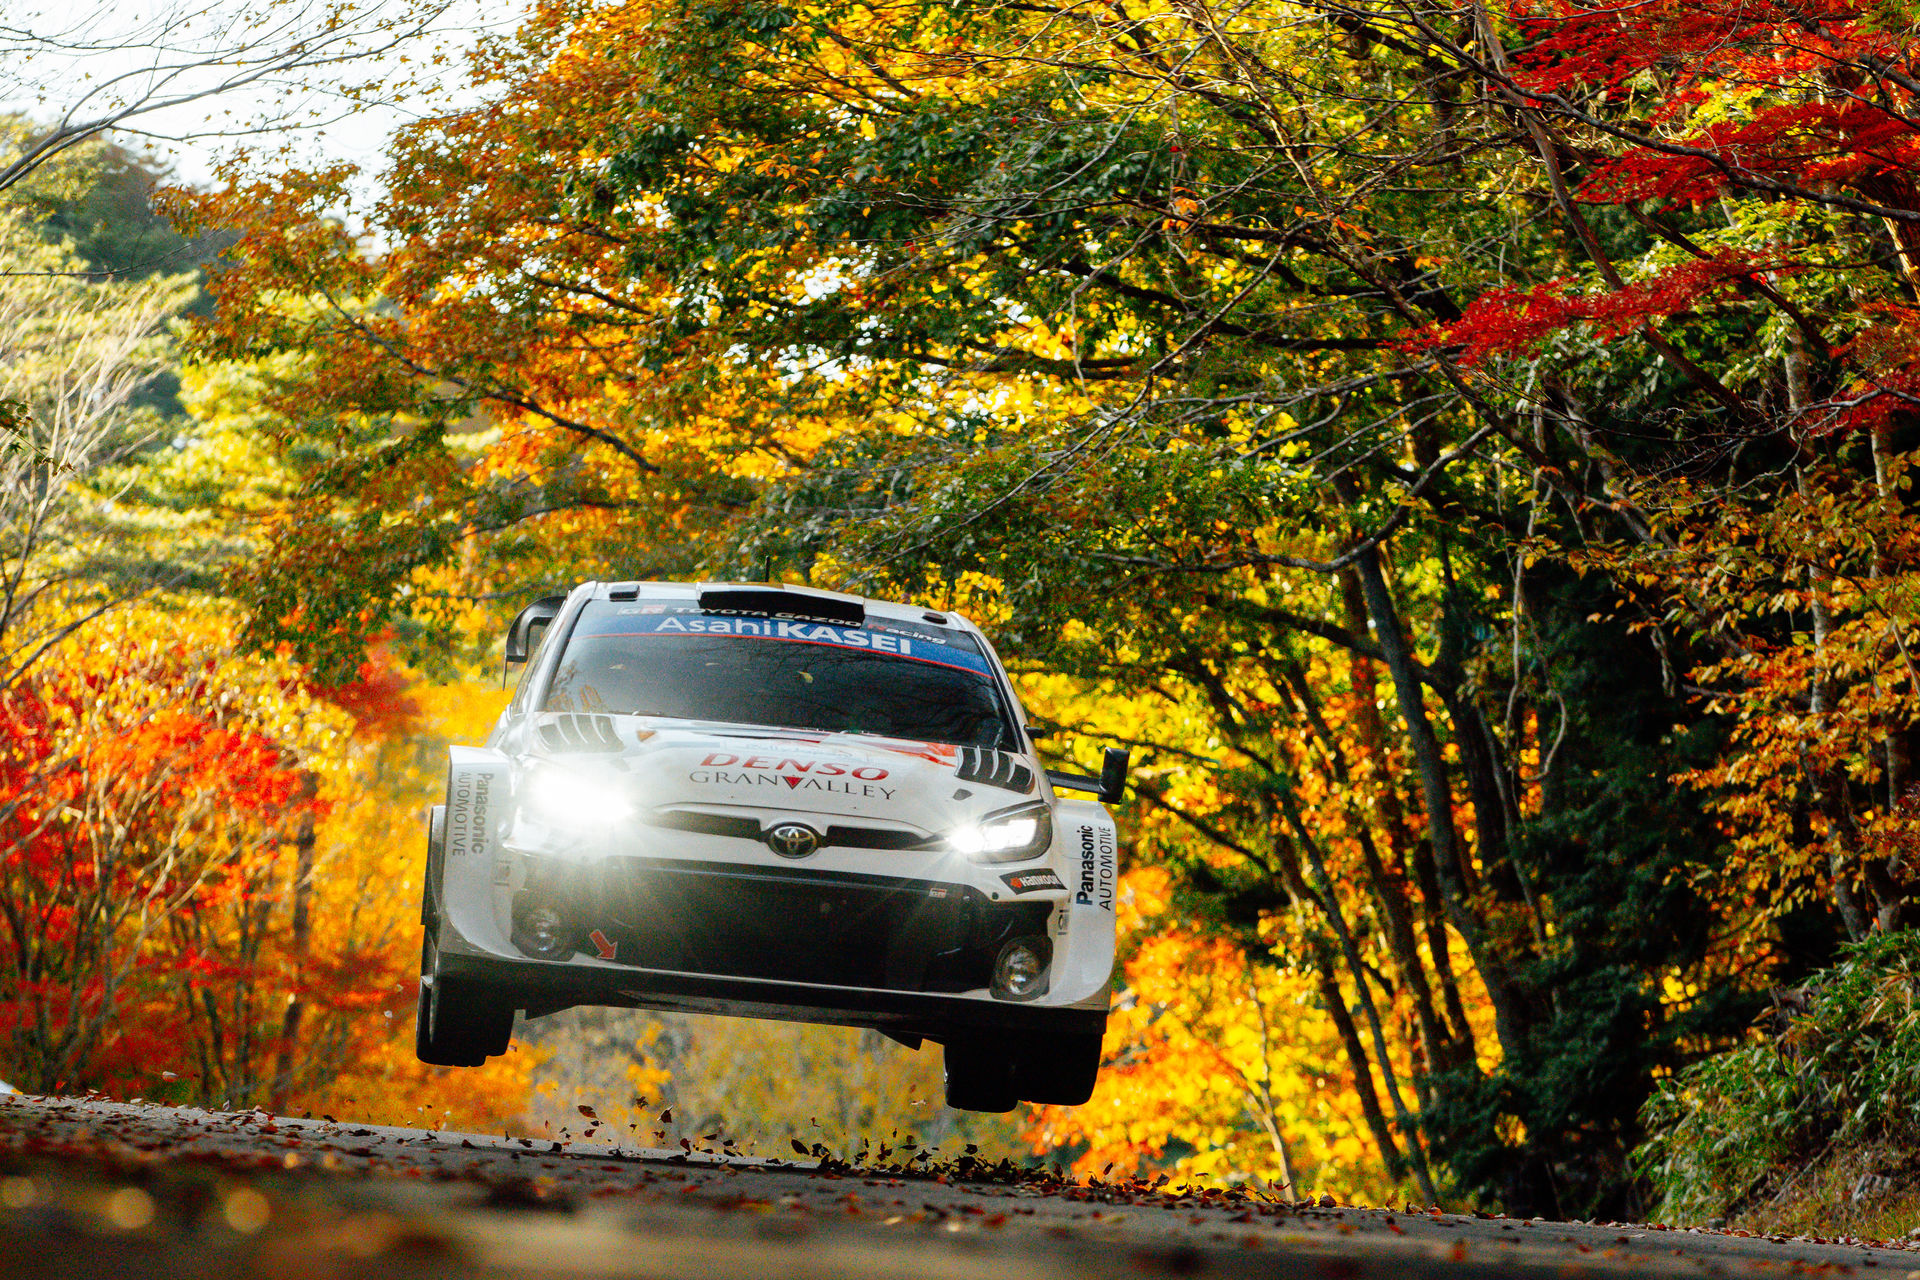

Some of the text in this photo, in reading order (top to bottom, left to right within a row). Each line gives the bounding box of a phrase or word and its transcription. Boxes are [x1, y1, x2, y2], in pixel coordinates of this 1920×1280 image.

[672, 607, 768, 616] TOYOTA
[774, 612, 862, 627] GAZOO
[867, 624, 947, 645] Racing
[700, 753, 889, 781] DENSO
[452, 772, 471, 856] AUTOMOTIVE
[471, 773, 494, 854] Panasonic
[1076, 825, 1094, 905] Panasonic
[1098, 826, 1113, 911] AUTOMOTIVE
